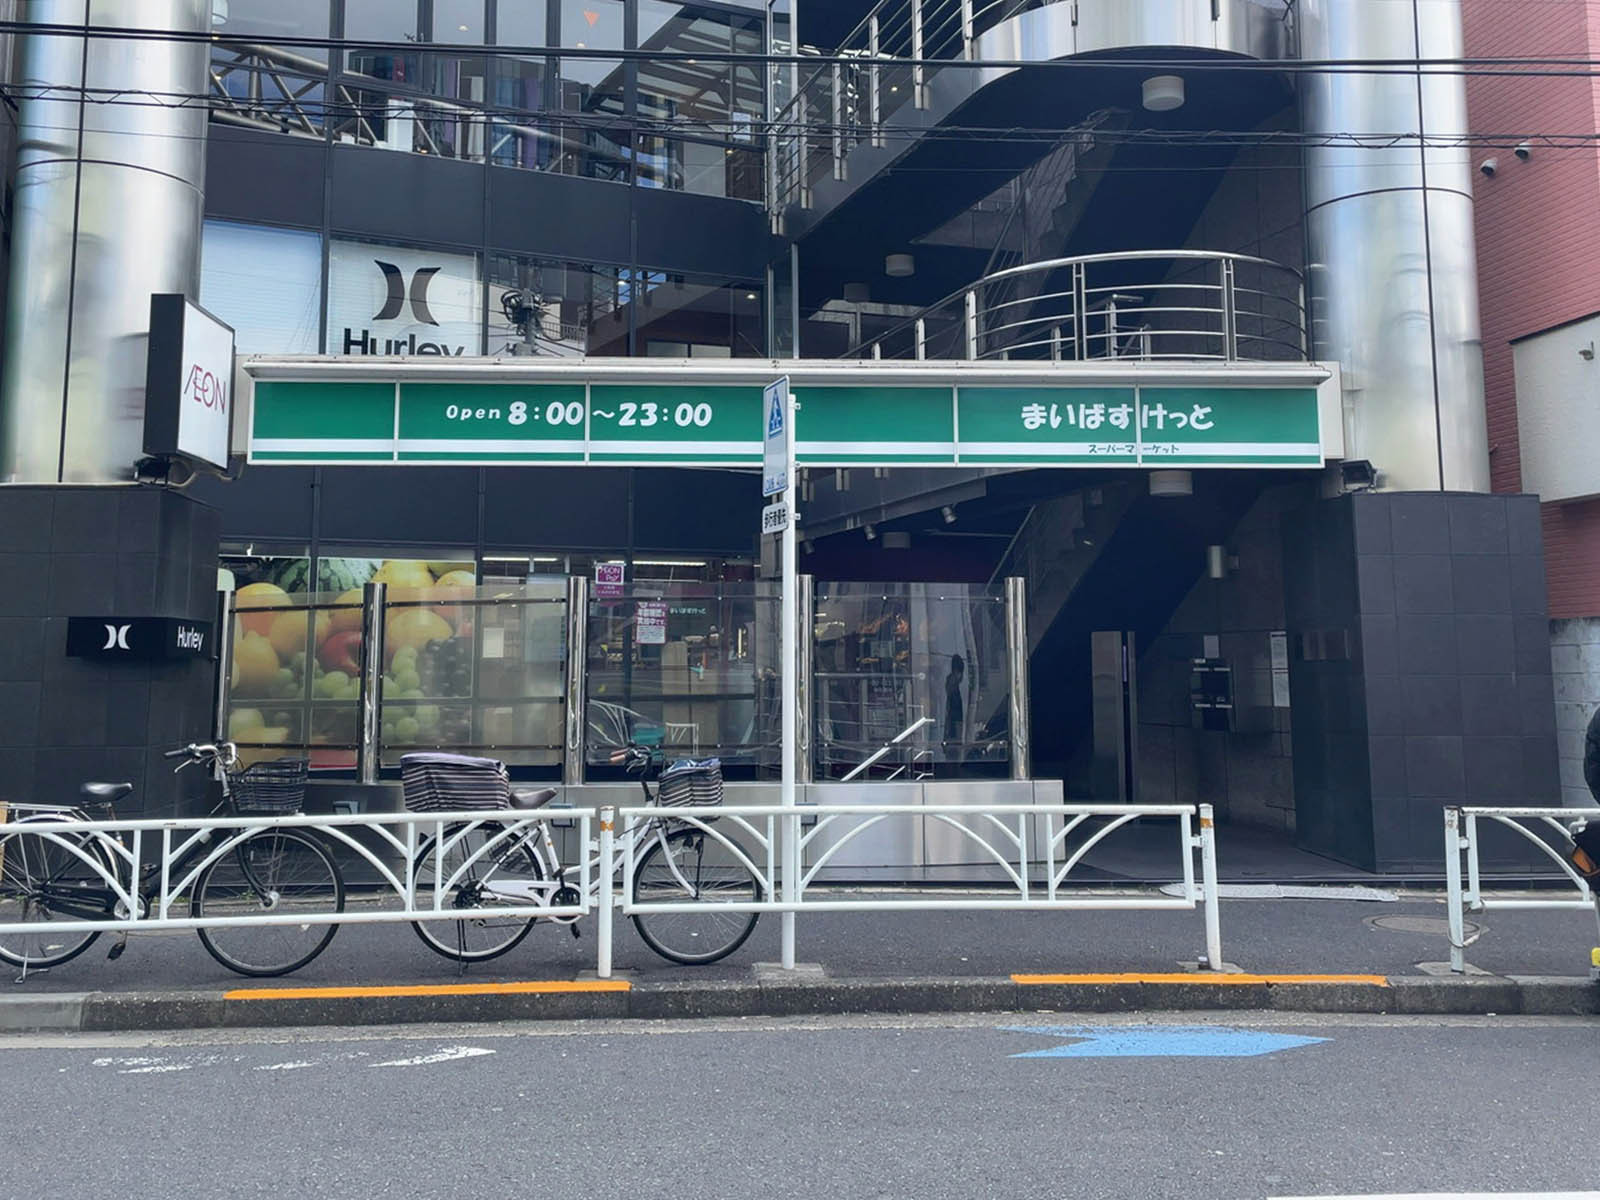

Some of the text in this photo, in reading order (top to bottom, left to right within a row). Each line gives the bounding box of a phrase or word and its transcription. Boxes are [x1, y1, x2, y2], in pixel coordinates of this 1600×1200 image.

[446, 405, 500, 421] Open
[1021, 403, 1215, 430] まいばすけっと
[176, 625, 204, 652] Hurley
